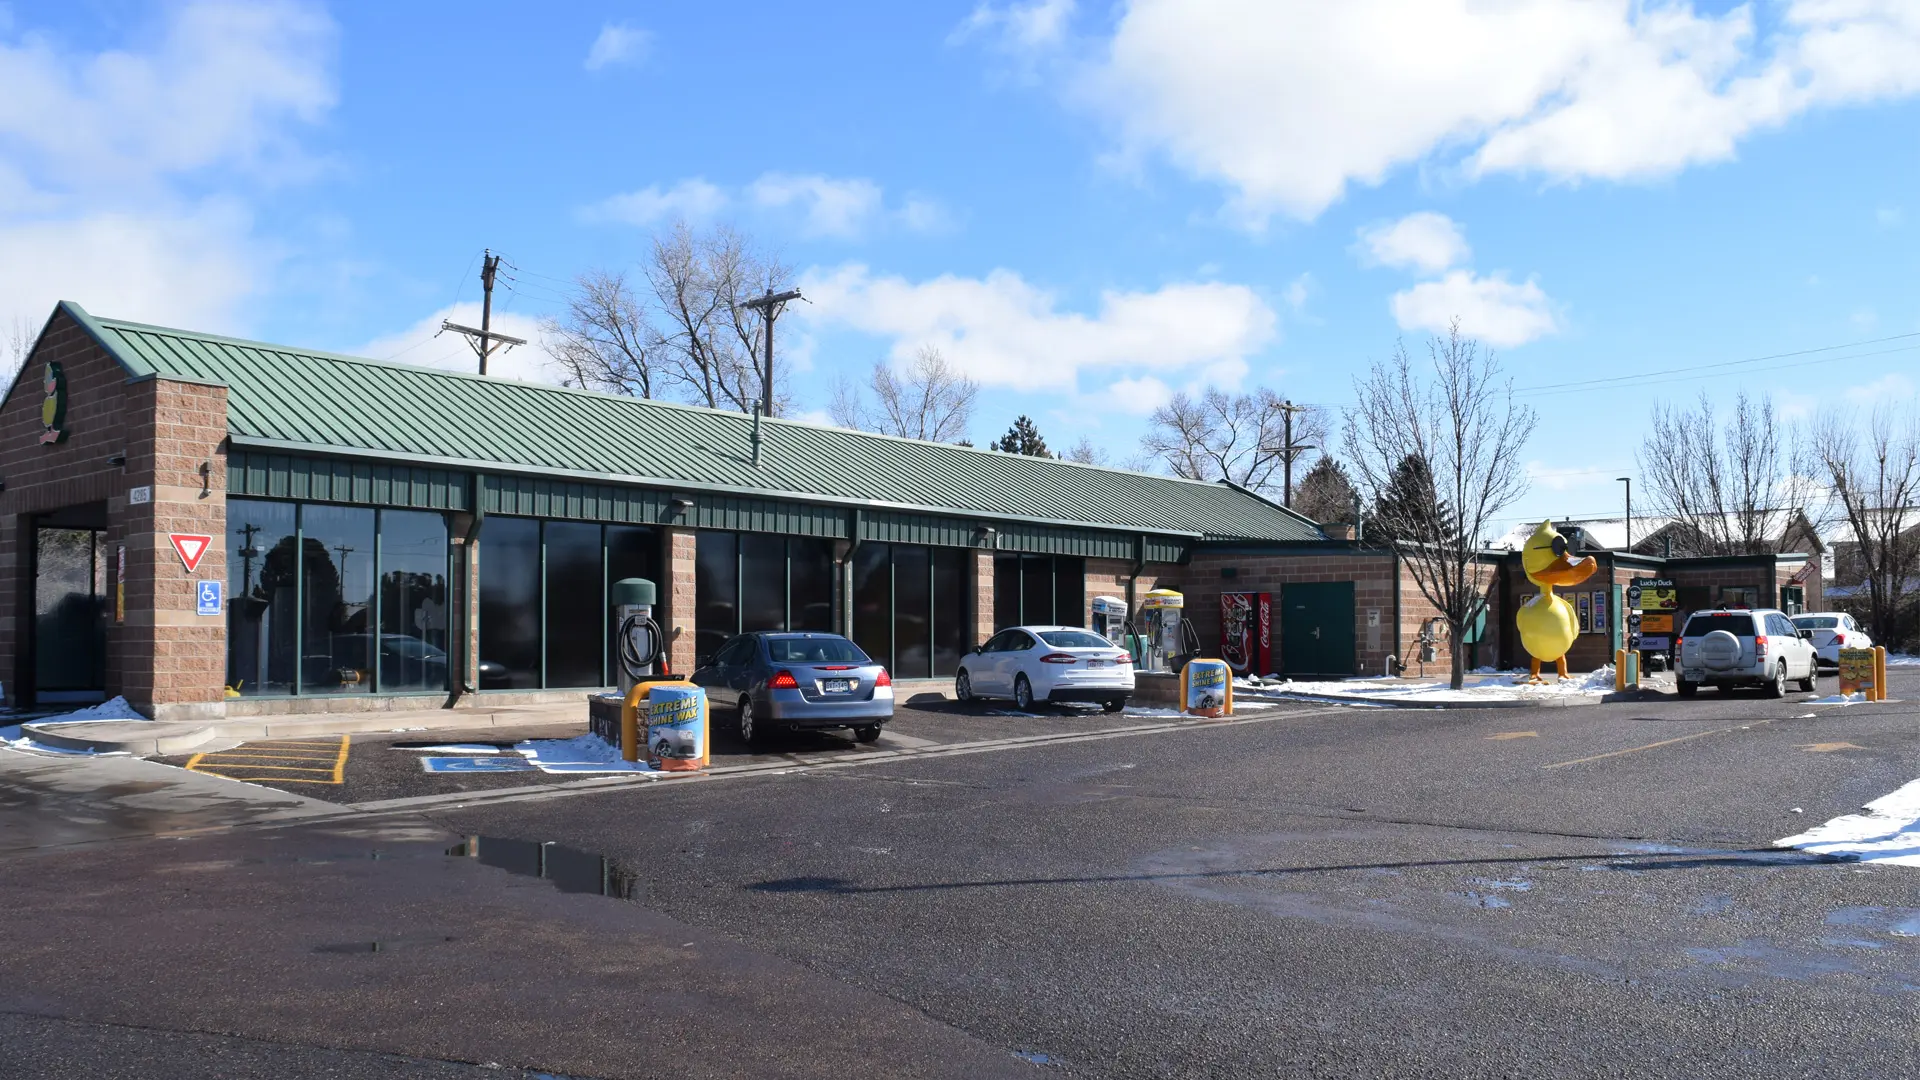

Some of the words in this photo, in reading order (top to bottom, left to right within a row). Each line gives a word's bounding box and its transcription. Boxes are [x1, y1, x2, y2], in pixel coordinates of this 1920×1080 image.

[1192, 667, 1224, 680] EXTREME
[1192, 679, 1211, 688] SHINE
[650, 696, 698, 715] EXTREME
[647, 714, 674, 727] SHINE
[676, 707, 698, 721] WAX
